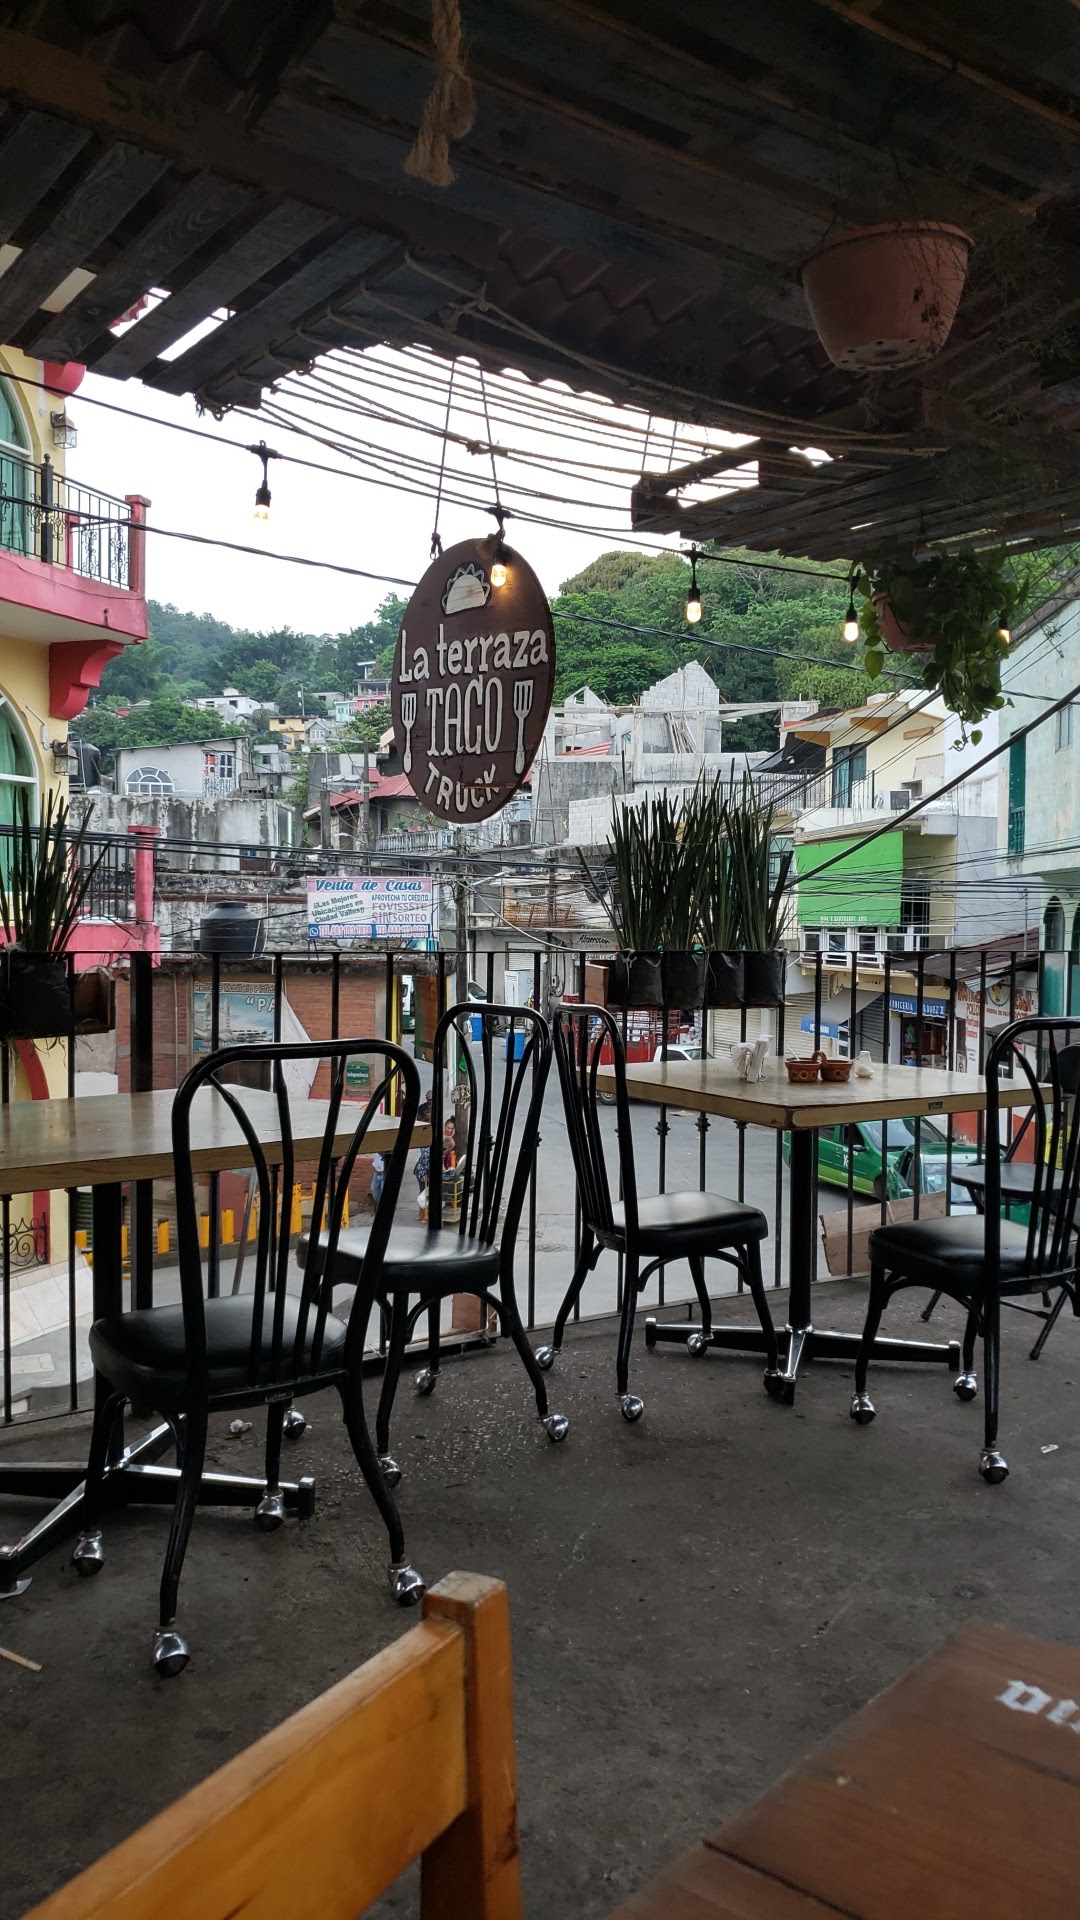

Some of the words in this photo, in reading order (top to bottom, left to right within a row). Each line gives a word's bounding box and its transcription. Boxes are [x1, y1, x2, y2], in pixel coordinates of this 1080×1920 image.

[399, 629, 430, 683] La
[436, 623, 548, 676] terraza
[426, 674, 504, 758] TACO
[423, 761, 500, 813] TRUCK
[315, 878, 355, 891] Venta
[361, 879, 380, 891] de
[385, 879, 424, 892] Casas
[330, 893, 358, 904] Mejores
[311, 902, 354, 917] Ubicaciones
[372, 902, 428, 911] FOVISSSTE
[314, 912, 338, 923] Ciudad
[392, 913, 428, 923] SORTEO
